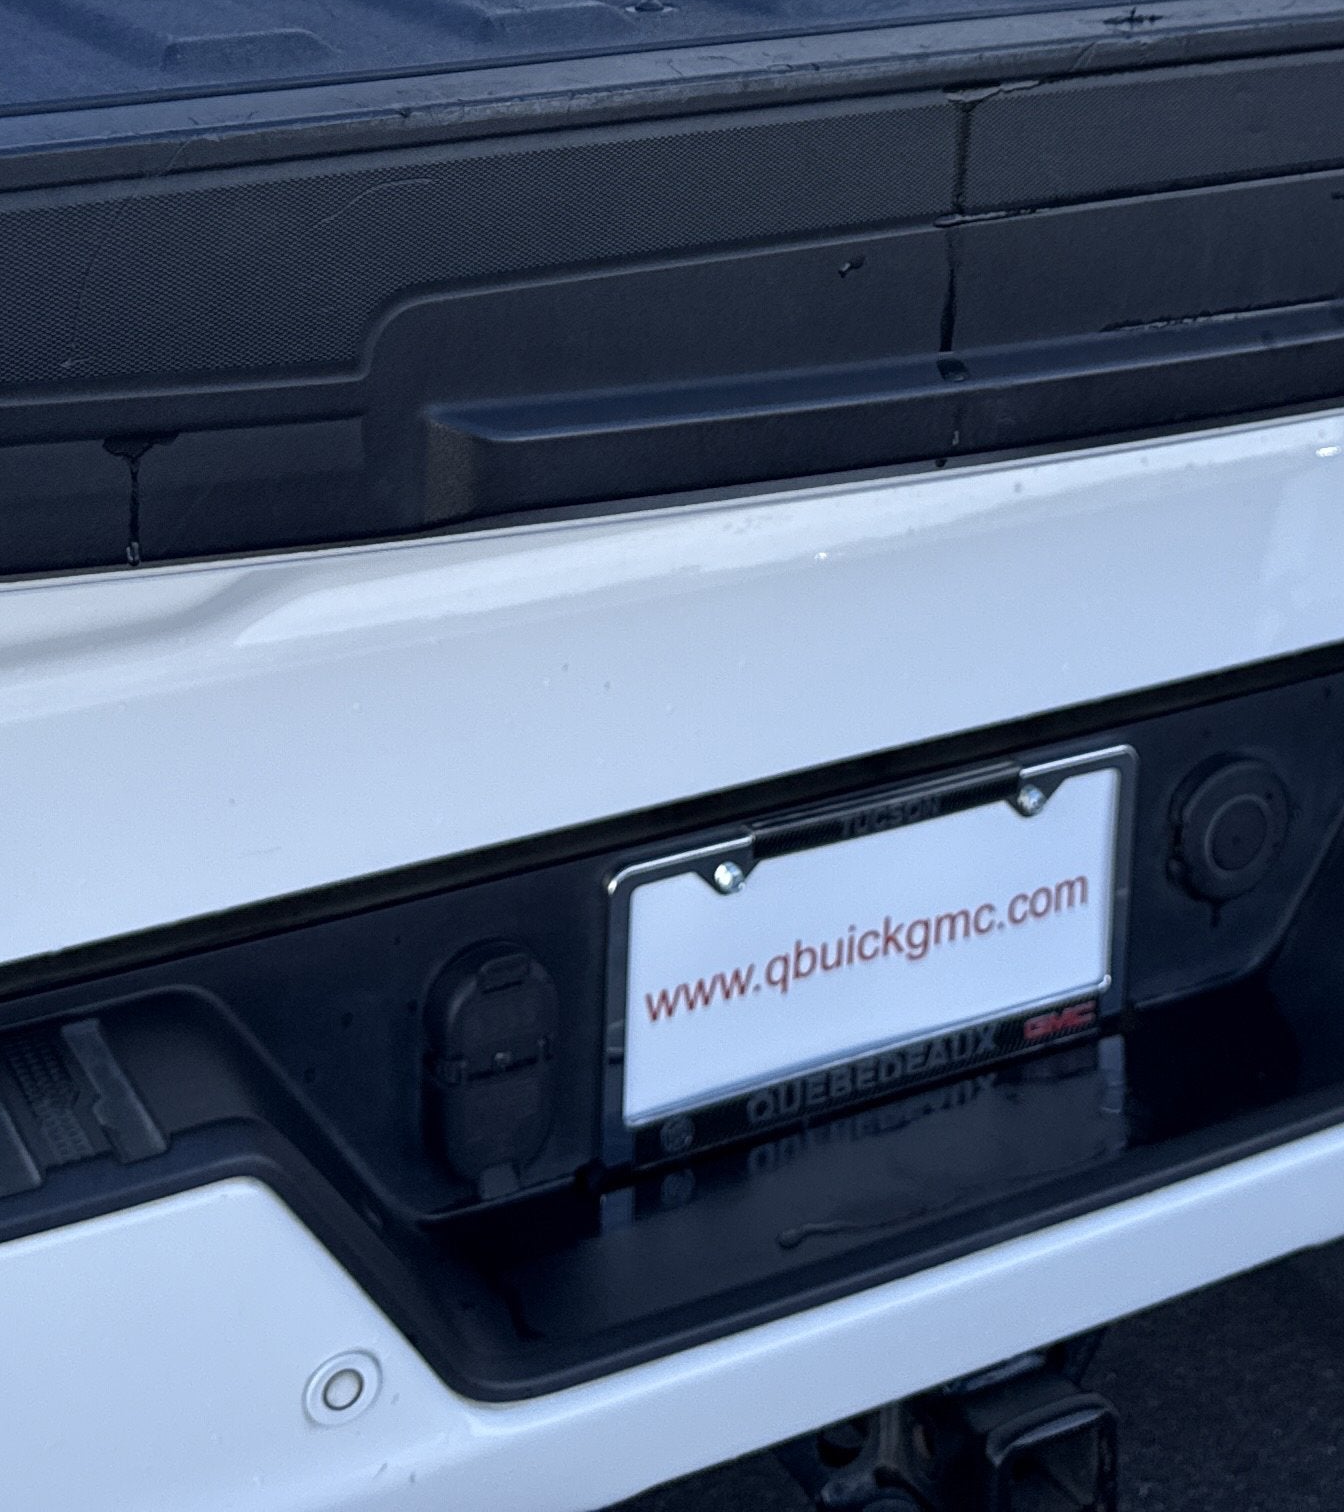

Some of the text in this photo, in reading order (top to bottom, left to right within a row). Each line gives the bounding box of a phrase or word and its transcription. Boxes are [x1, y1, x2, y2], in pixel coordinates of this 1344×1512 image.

[645, 874, 1089, 1023] www.qbuickgmc.com
[746, 1023, 1000, 1127] QUEBEDEAUX
[1023, 999, 1098, 1042] GMC
